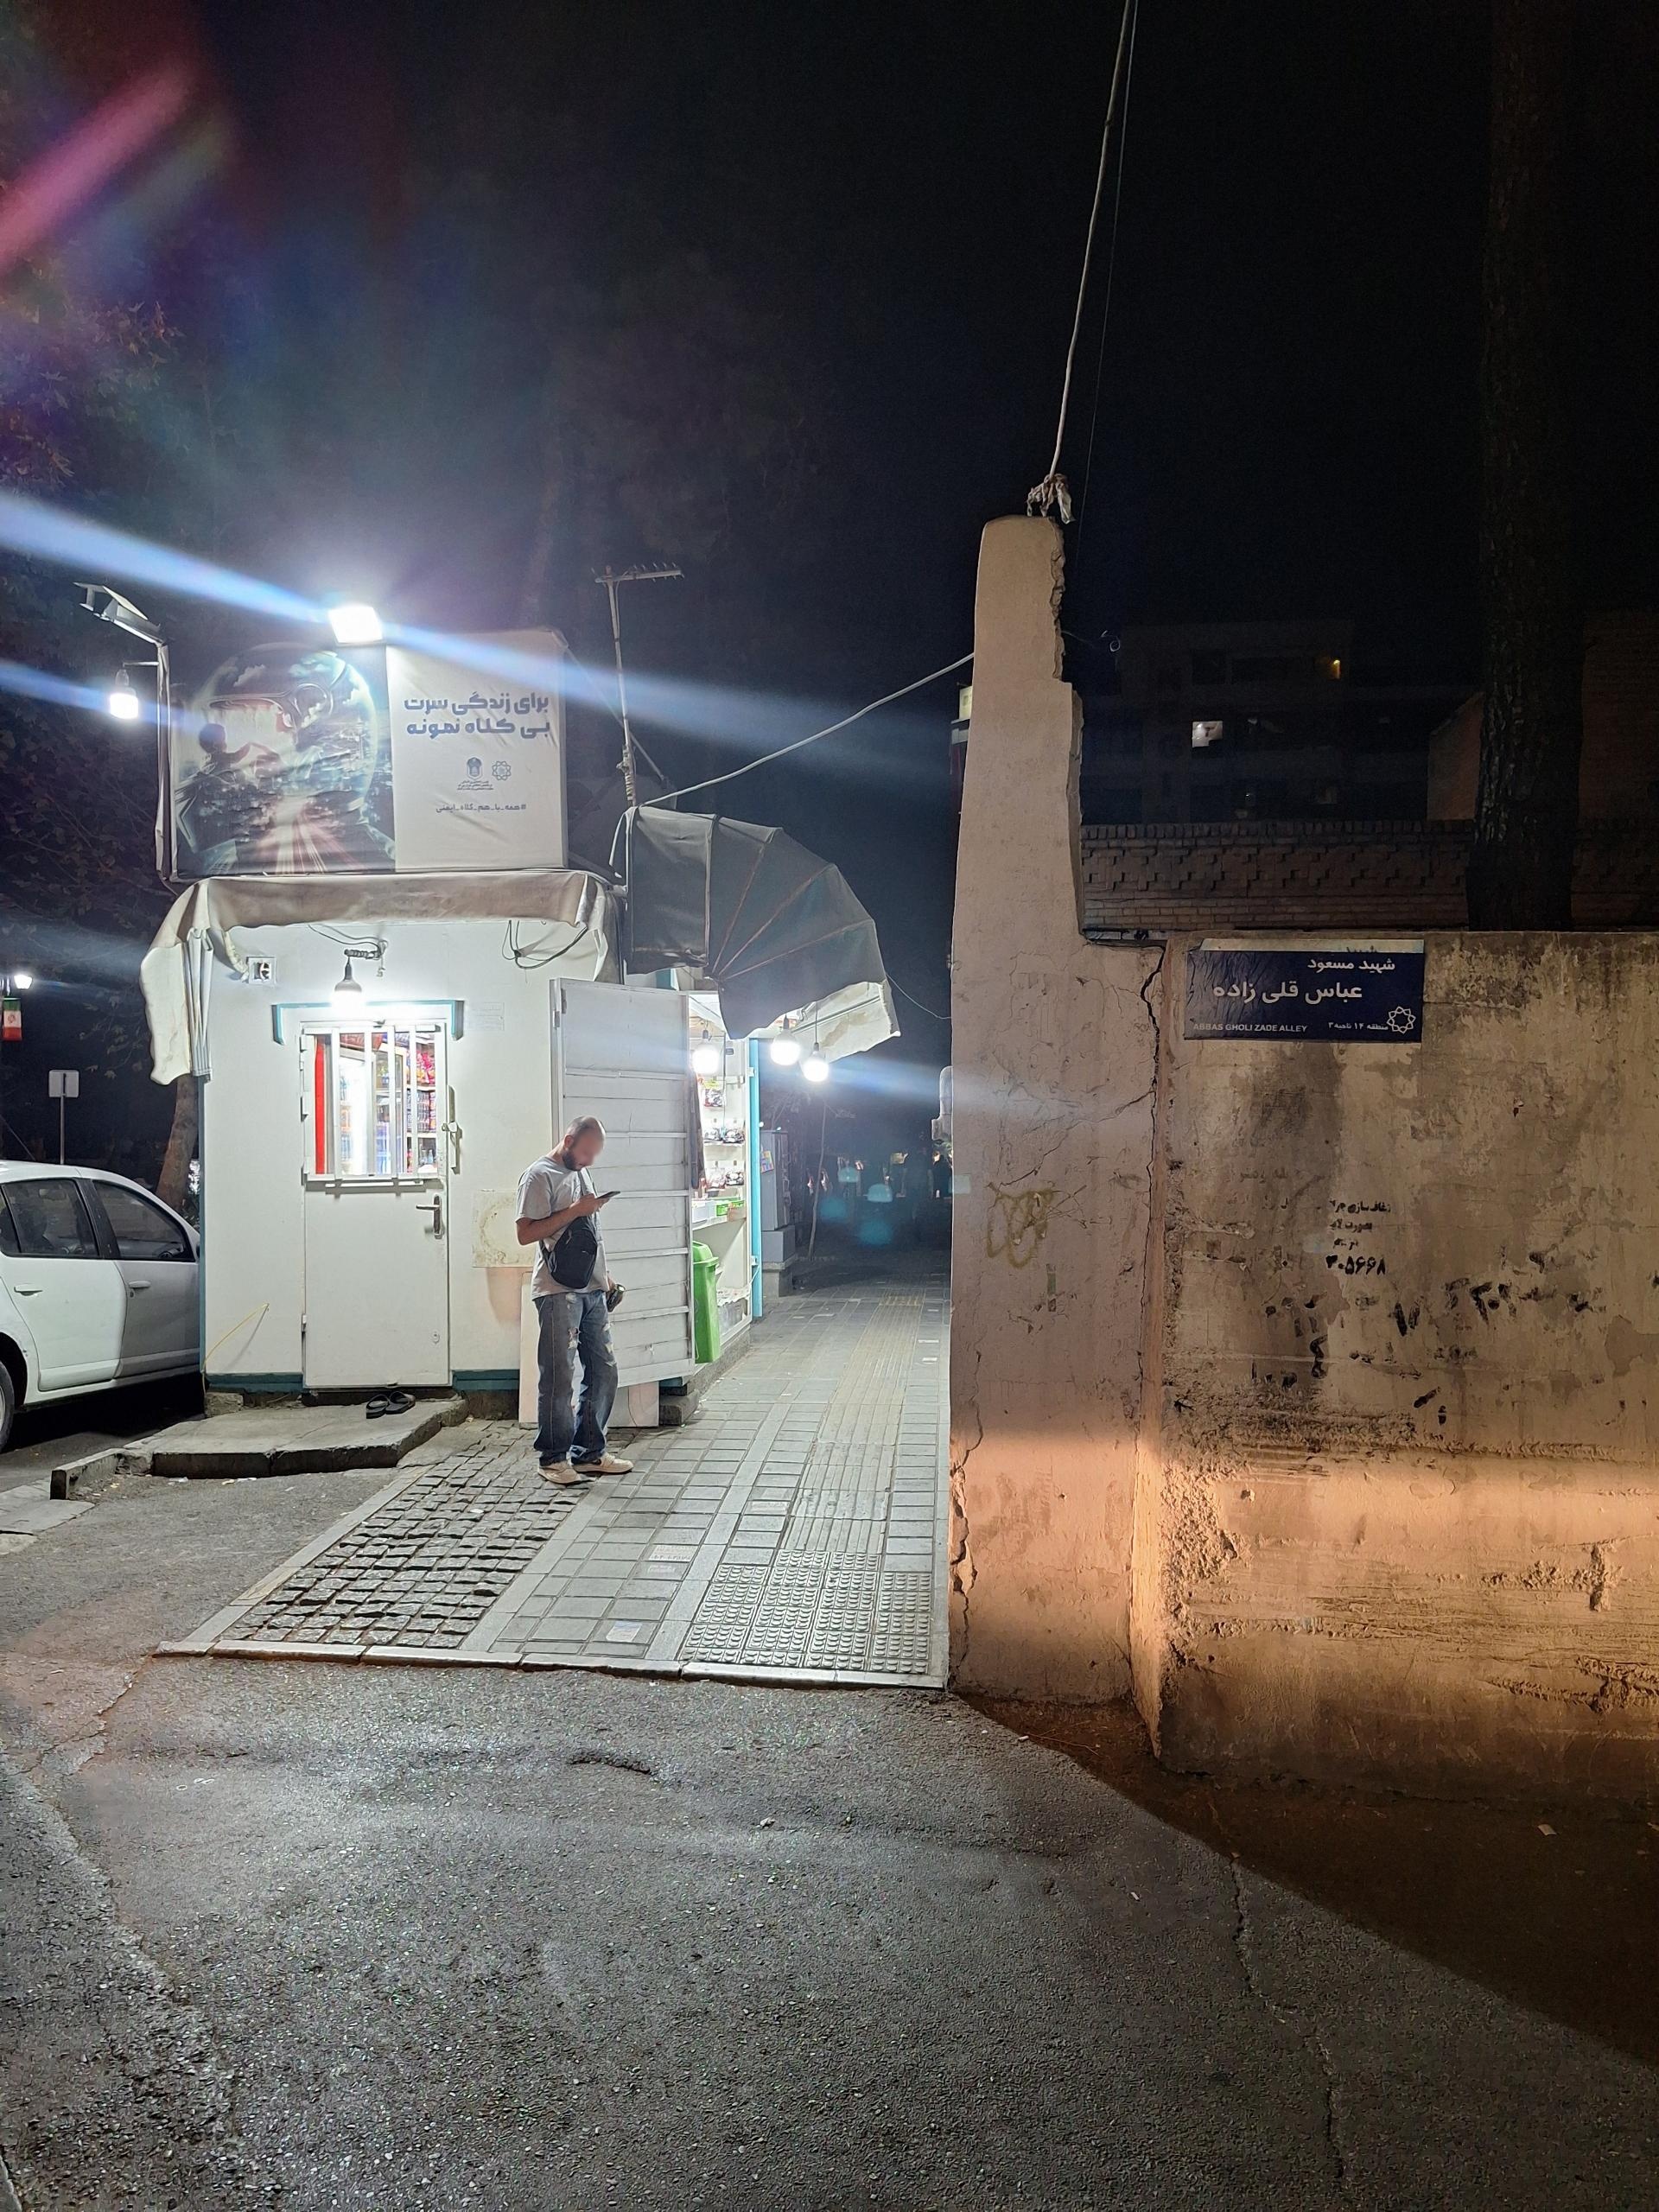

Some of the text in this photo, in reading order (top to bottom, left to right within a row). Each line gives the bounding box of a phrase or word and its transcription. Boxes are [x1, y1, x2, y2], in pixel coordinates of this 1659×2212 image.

[404, 691, 548, 715] برای زندگی سرت
[406, 718, 550, 740] بی کلاه نمونه
[1306, 957, 1396, 974] شهید مسعود
[1211, 980, 1363, 1005] عباس قلی زاده
[1192, 1022, 1224, 1031] ABBAS
[1225, 1023, 1253, 1032] GHOLI
